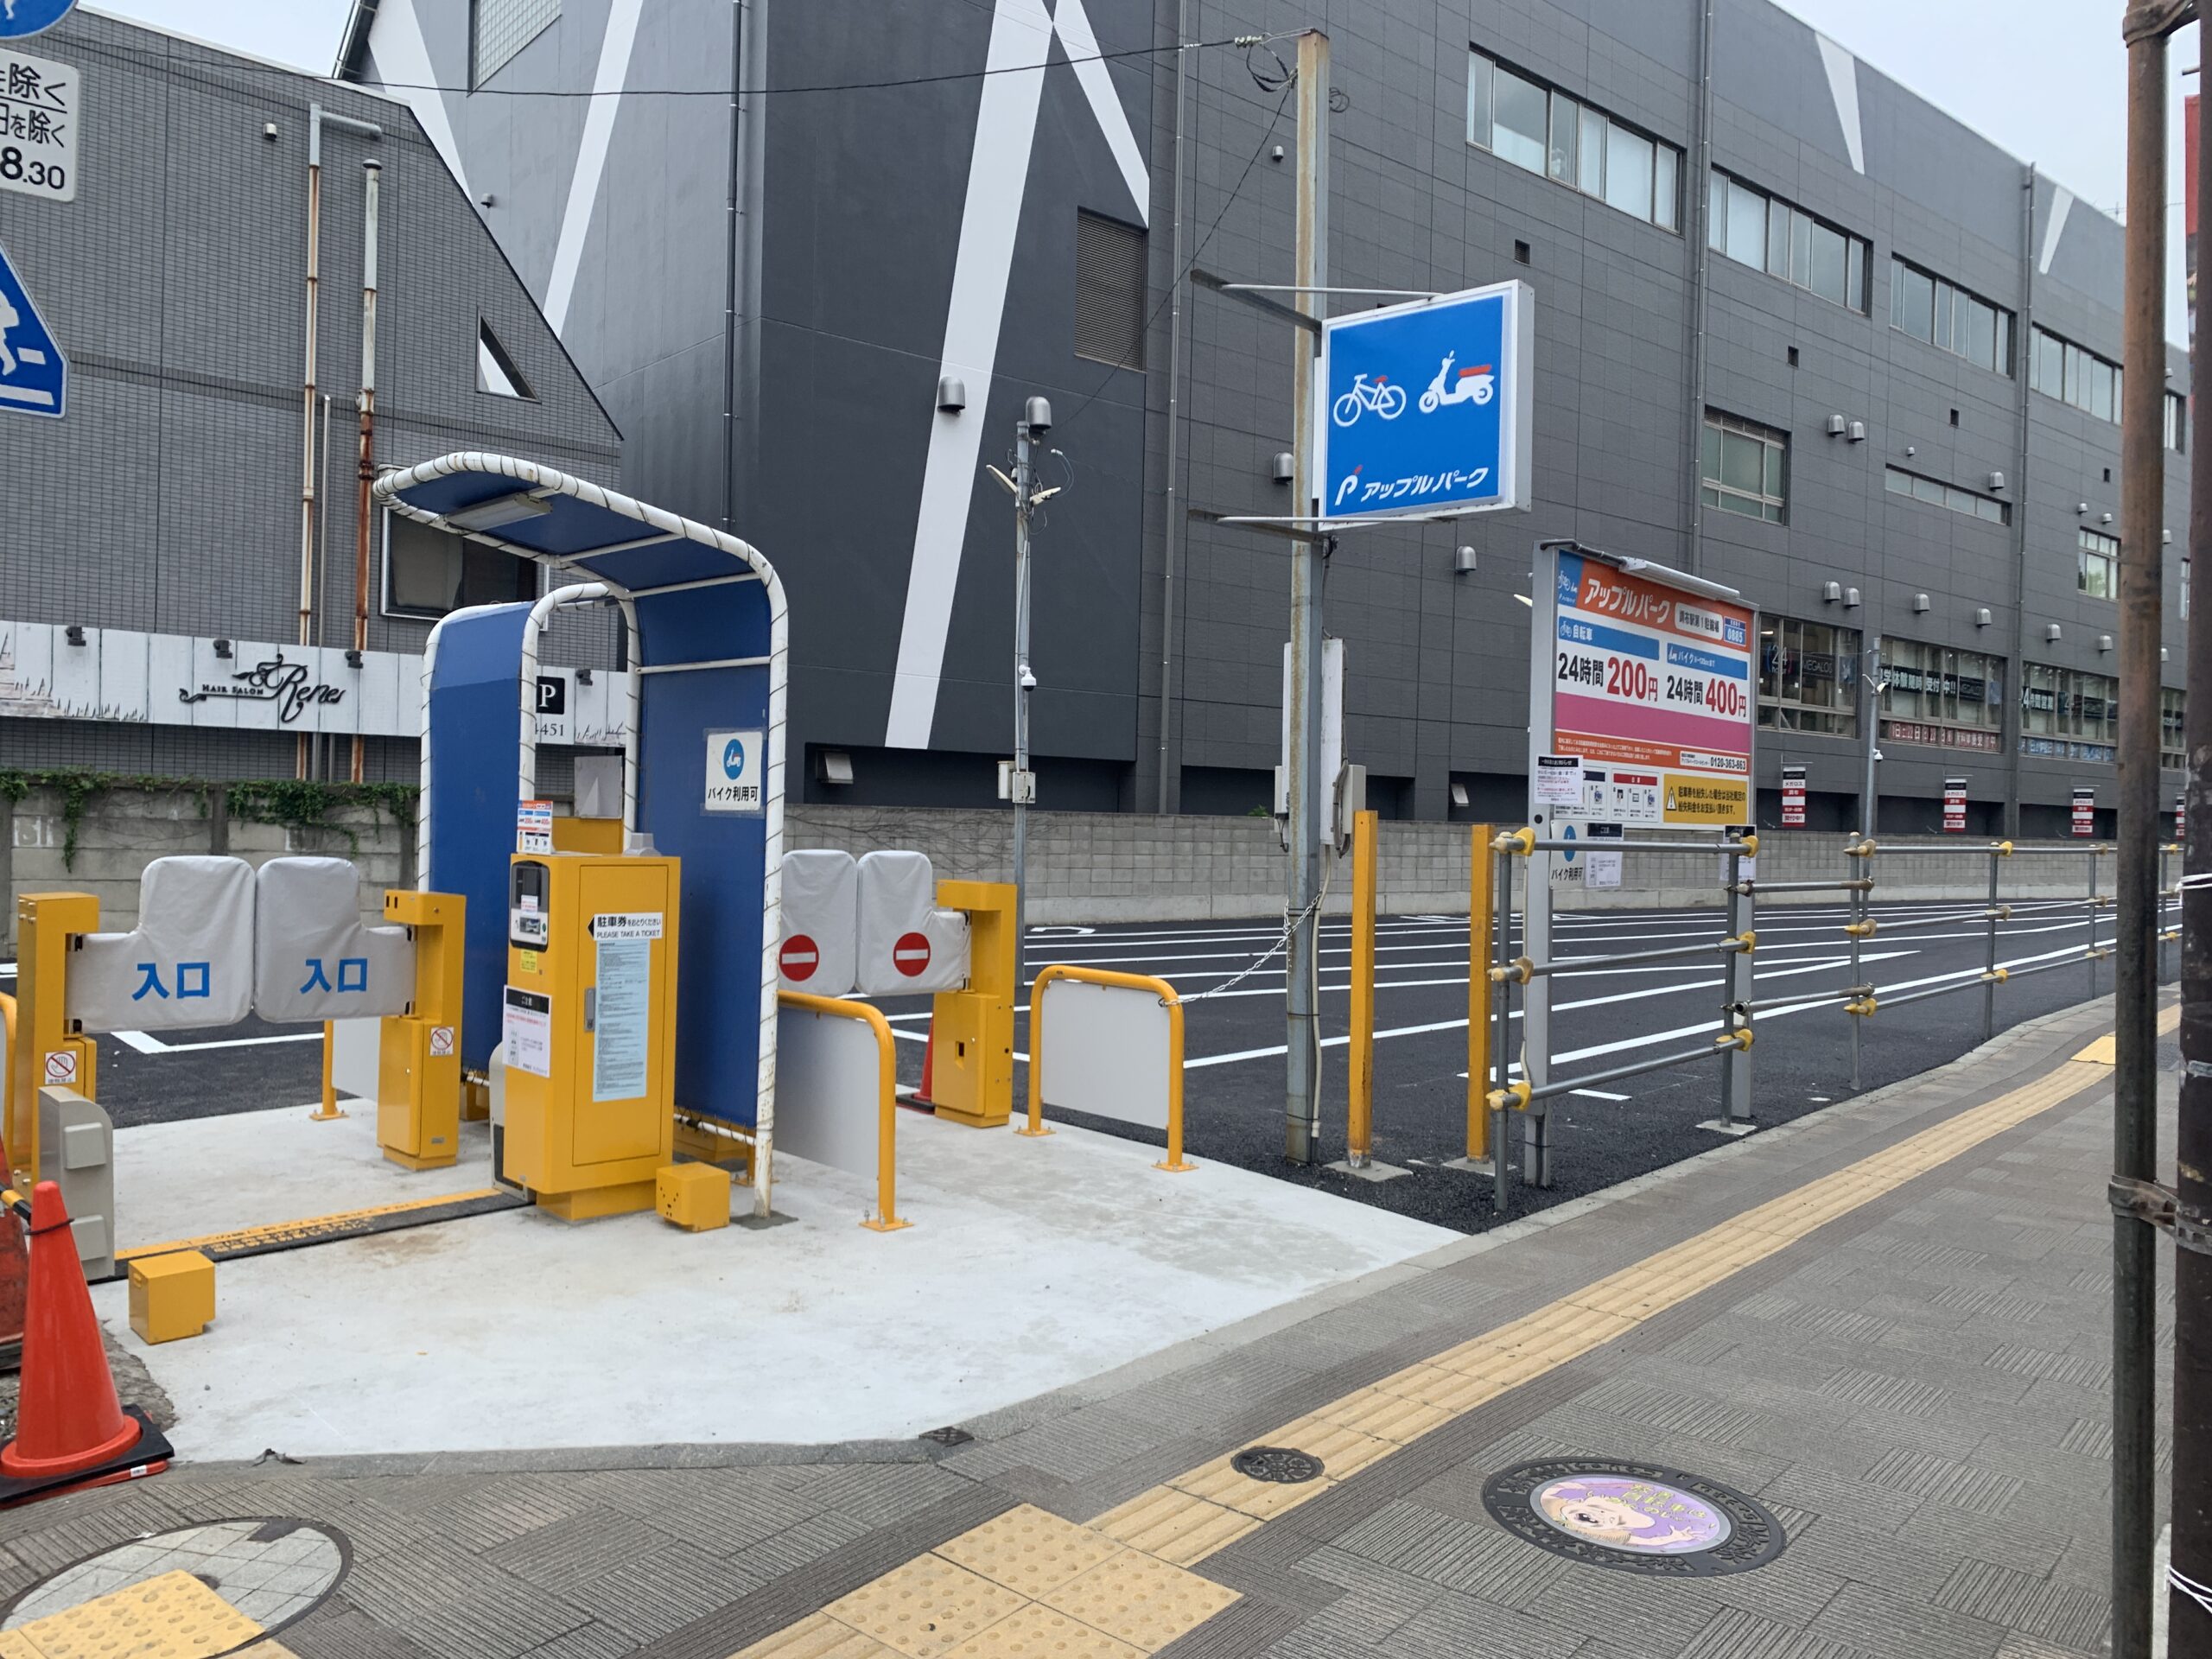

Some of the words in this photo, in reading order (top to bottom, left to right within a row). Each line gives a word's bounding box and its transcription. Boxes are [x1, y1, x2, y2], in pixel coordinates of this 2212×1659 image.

[0, 63, 66, 106] 除く
[1361, 467, 1489, 502] アップルパーク
[1585, 578, 1670, 623] アップルパーク
[1573, 624, 1592, 640] 自転車
[202, 683, 227, 694] HAIR
[232, 685, 264, 695] SALON
[538, 683, 556, 707] P
[1558, 652, 1604, 687] 24時間
[1607, 656, 1658, 702] 200円
[1667, 675, 1703, 705] 24時間
[1706, 677, 1746, 717] 400円
[708, 785, 758, 803] バイク利用可
[132, 962, 210, 1001] 入口
[300, 957, 368, 995] 入口
